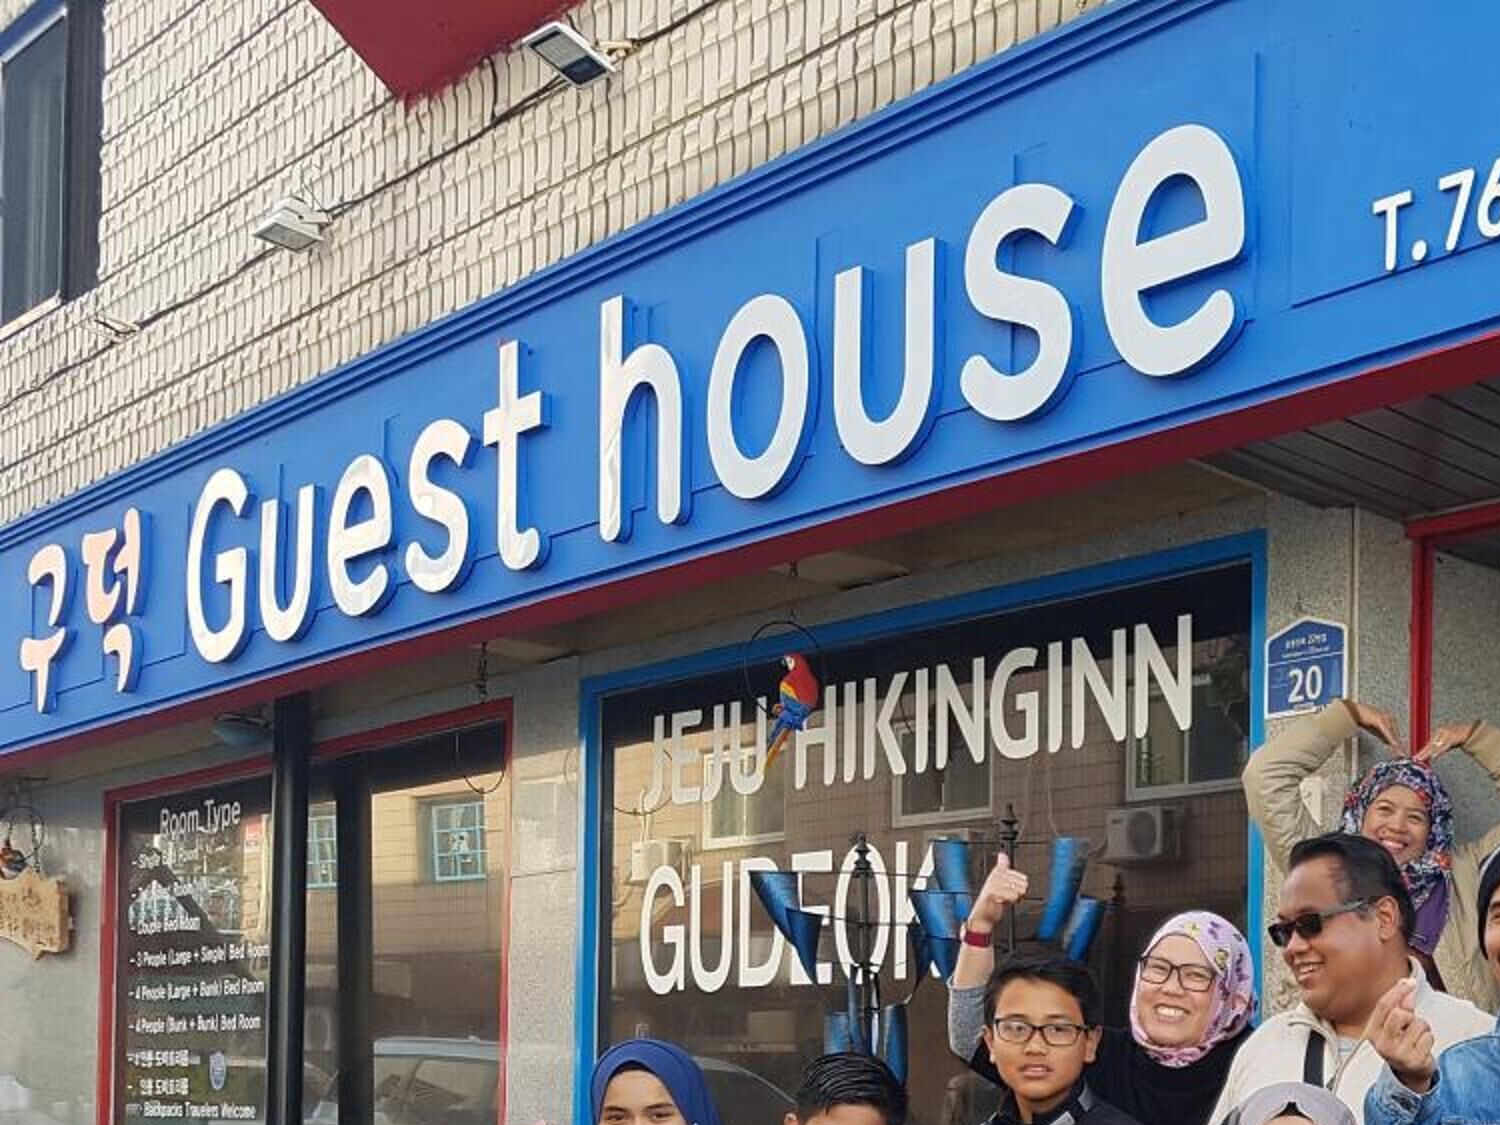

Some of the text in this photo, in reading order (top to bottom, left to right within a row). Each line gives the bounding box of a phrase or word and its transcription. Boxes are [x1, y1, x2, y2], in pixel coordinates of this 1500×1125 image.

[20, 123, 1246, 713] 구덕 Guest house
[1288, 664, 1323, 703] 20
[640, 614, 1193, 810] JEJU HIKINGINN
[160, 800, 241, 835] Room Type
[640, 841, 941, 995] GUDEOK
[229, 943, 245, 960] Bed
[224, 980, 240, 995] Bed
[242, 977, 265, 994] Room
[221, 1014, 237, 1031] Bed
[239, 1013, 261, 1030] Room
